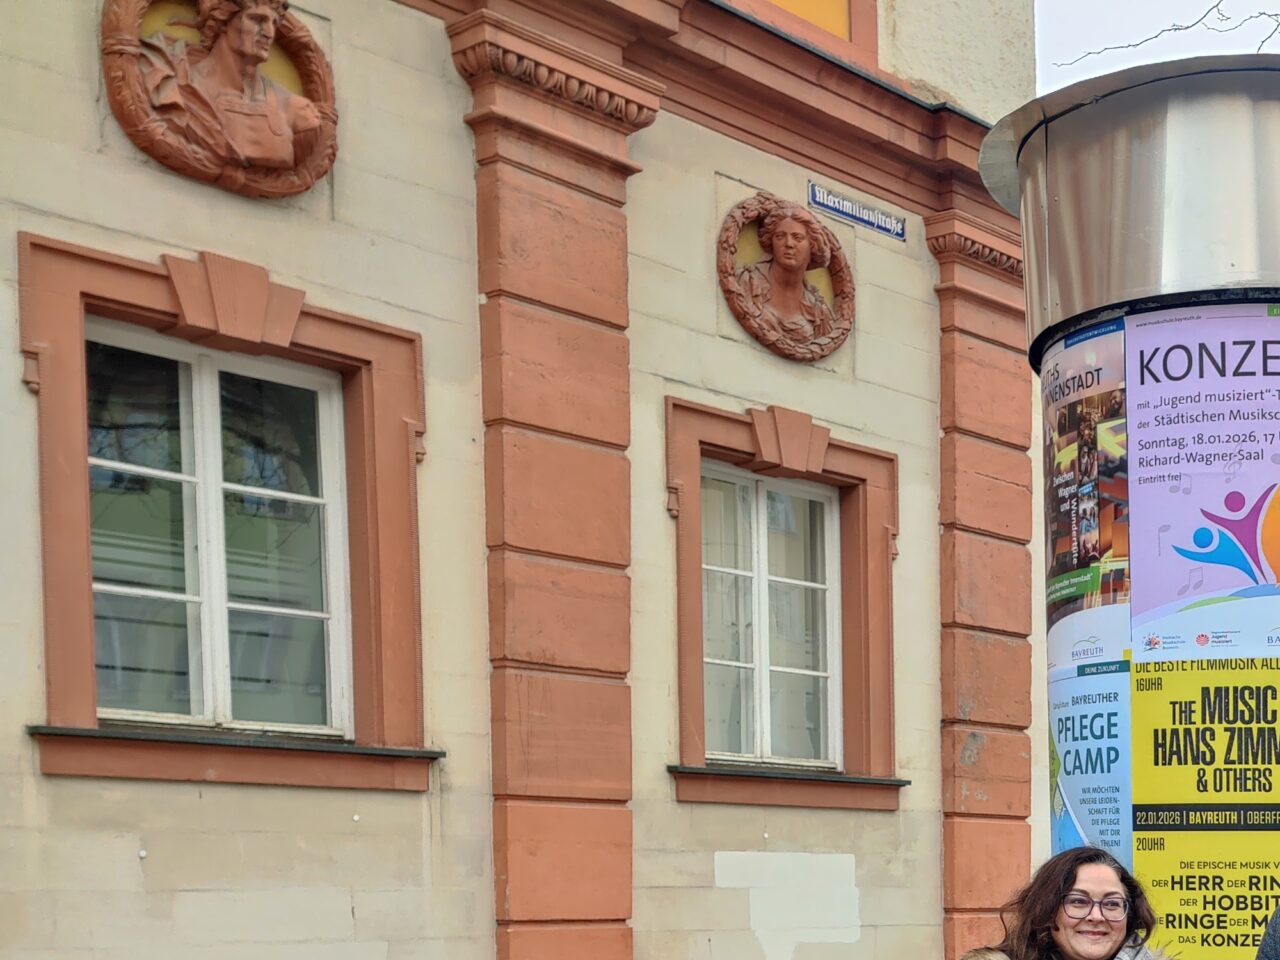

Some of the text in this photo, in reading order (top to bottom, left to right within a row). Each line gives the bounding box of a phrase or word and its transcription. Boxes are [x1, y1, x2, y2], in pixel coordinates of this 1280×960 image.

[1137, 401, 1150, 411] mit
[1153, 393, 1201, 410] „Jugend
[1137, 420, 1150, 430] der
[1154, 410, 1225, 427] Städtischen
[1138, 438, 1189, 451] Sonntag,
[1191, 431, 1261, 446] 18.01.2026,
[1263, 433, 1275, 444] 17
[1138, 448, 1264, 468] Richard-Wagner-Saal
[1138, 472, 1182, 485] Eintritt frei
[1057, 483, 1078, 499] Wagner
[1060, 500, 1071, 513] und
[1099, 664, 1120, 673] ZUKUNFT
[1136, 660, 1151, 673] DIE
[1153, 659, 1187, 673] BESTE
[1190, 658, 1258, 672] FILMMUSIK
[1136, 677, 1163, 692] 16UHR
[1071, 692, 1119, 706] BAYREUTHER
[1170, 700, 1196, 725] THE
[1201, 685, 1278, 725] MUSIC
[1058, 711, 1119, 744] PFLEGE
[1153, 727, 1216, 766] HANS
[1063, 746, 1120, 776] CAMP
[1196, 767, 1273, 793] & OTHERS
[1092, 785, 1120, 794] MÖCHTEN
[1080, 797, 1097, 805] UNSERE
[1088, 806, 1120, 815] SCHAFT FÜR
[1136, 811, 1181, 825] 22.01.2026
[1189, 811, 1238, 825] BAYREUTH
[1101, 818, 1120, 826] PFLEGE
[1136, 837, 1165, 851] 20UHR
[1179, 861, 1195, 870] DIE
[1197, 861, 1238, 870] EPISCHE
[1239, 861, 1271, 870] MUSIK
[1152, 880, 1169, 888] DER
[1170, 875, 1224, 891] HERR
[1226, 880, 1246, 888] DER
[1166, 914, 1228, 929] RINGE
[1229, 919, 1249, 927] DER
[1178, 934, 1262, 947] DAS KONZE
